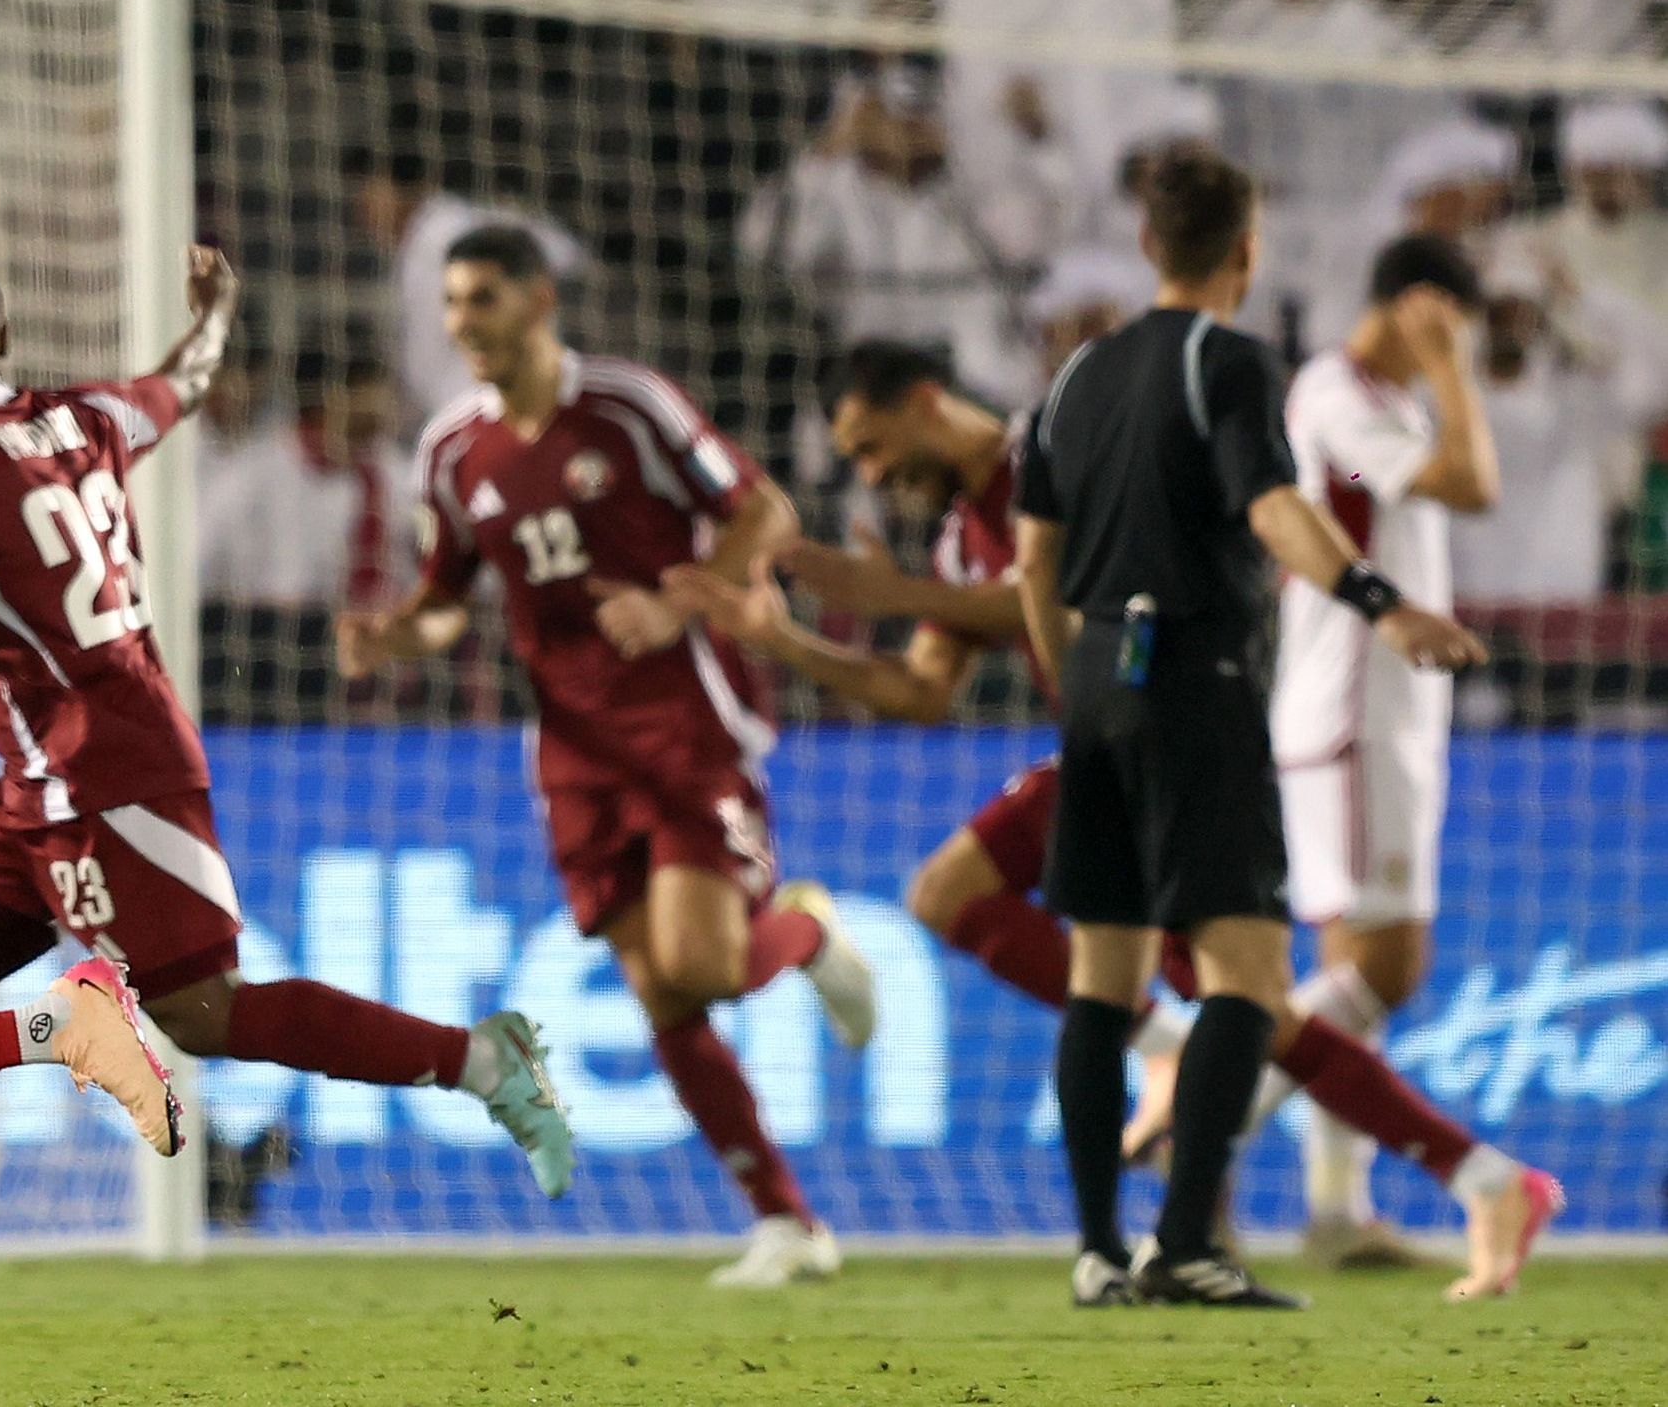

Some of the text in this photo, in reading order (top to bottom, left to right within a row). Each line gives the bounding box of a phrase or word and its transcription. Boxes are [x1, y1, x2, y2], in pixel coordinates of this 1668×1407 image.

[20, 468, 153, 652] 23
[512, 506, 591, 587] 12
[48, 855, 116, 930] 23
